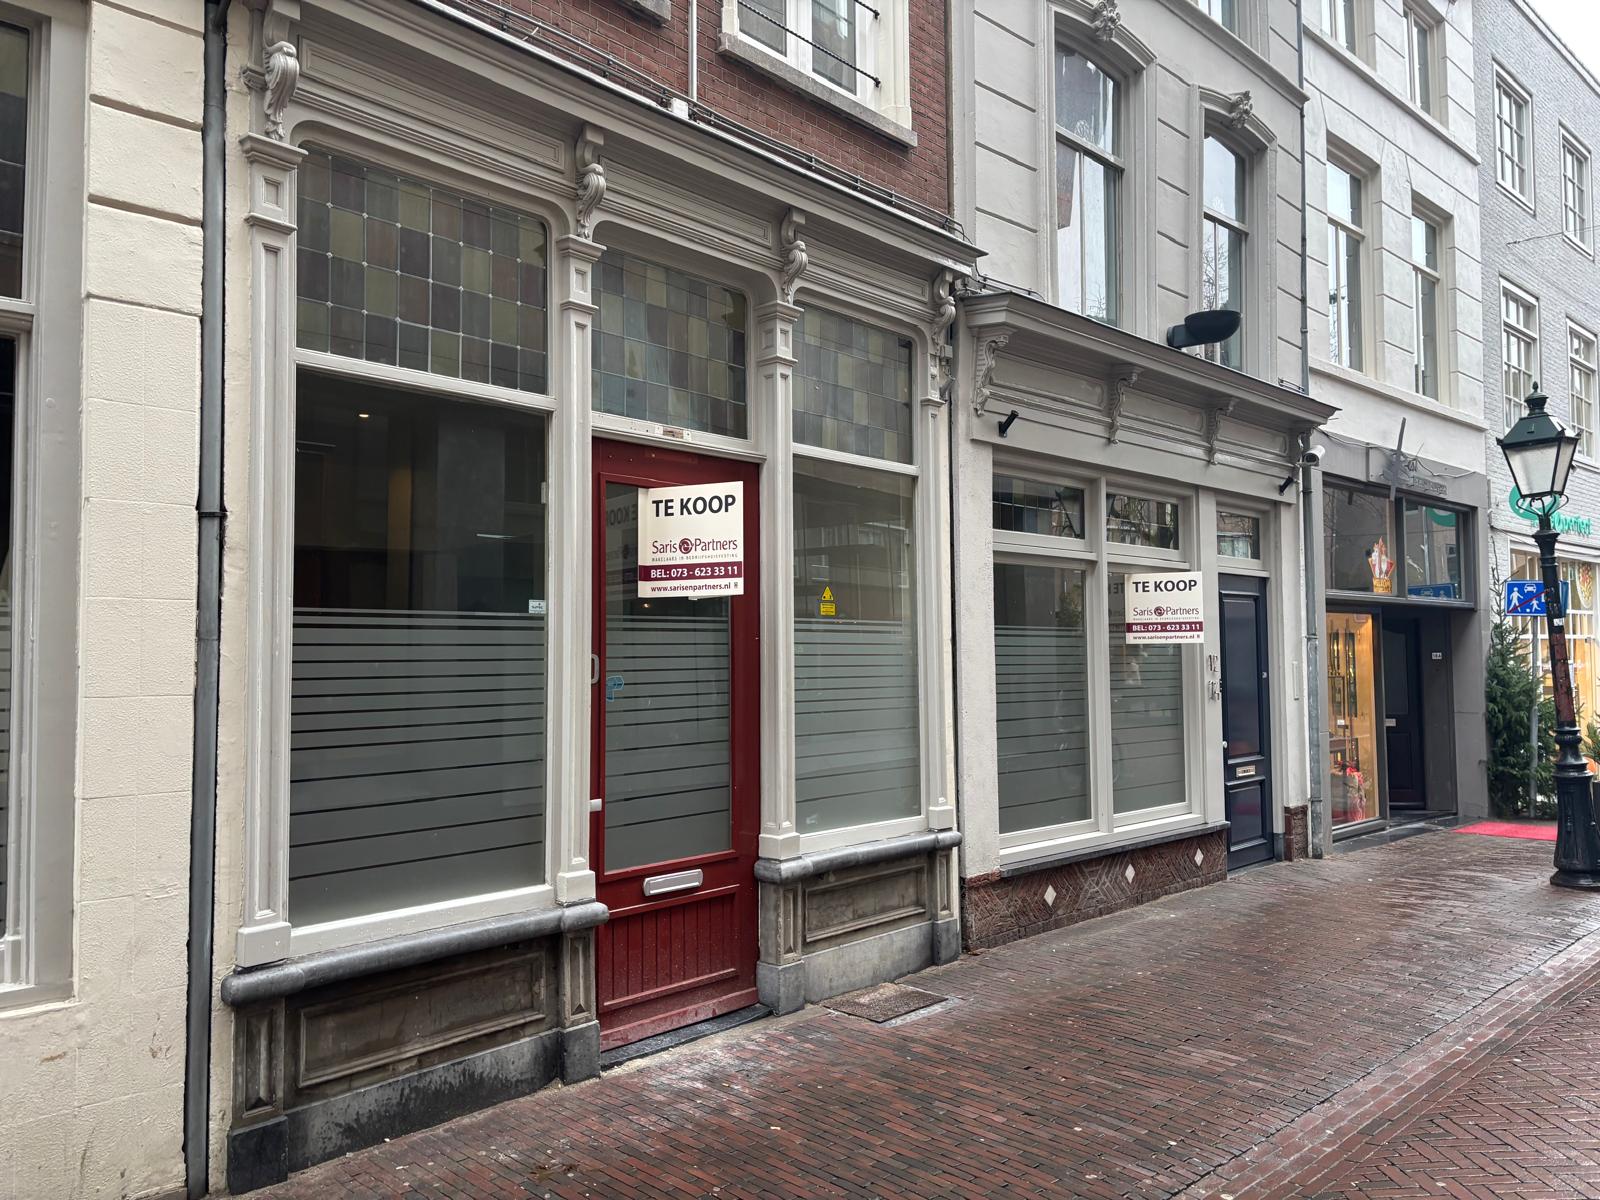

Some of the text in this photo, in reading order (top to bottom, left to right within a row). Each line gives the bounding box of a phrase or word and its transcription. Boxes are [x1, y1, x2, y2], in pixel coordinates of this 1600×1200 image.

[652, 494, 736, 517] TE KOOP
[652, 538, 738, 555] Saris Partners
[650, 569, 670, 578] BEL:
[671, 568, 688, 577] 073
[694, 567, 712, 576] 623
[714, 566, 725, 576] 33
[728, 566, 738, 575] 11
[651, 582, 730, 592] www.sarisenpartners.nl
[1132, 580, 1197, 593] TE KOOP
[1133, 606, 1199, 616] Saris Partners
